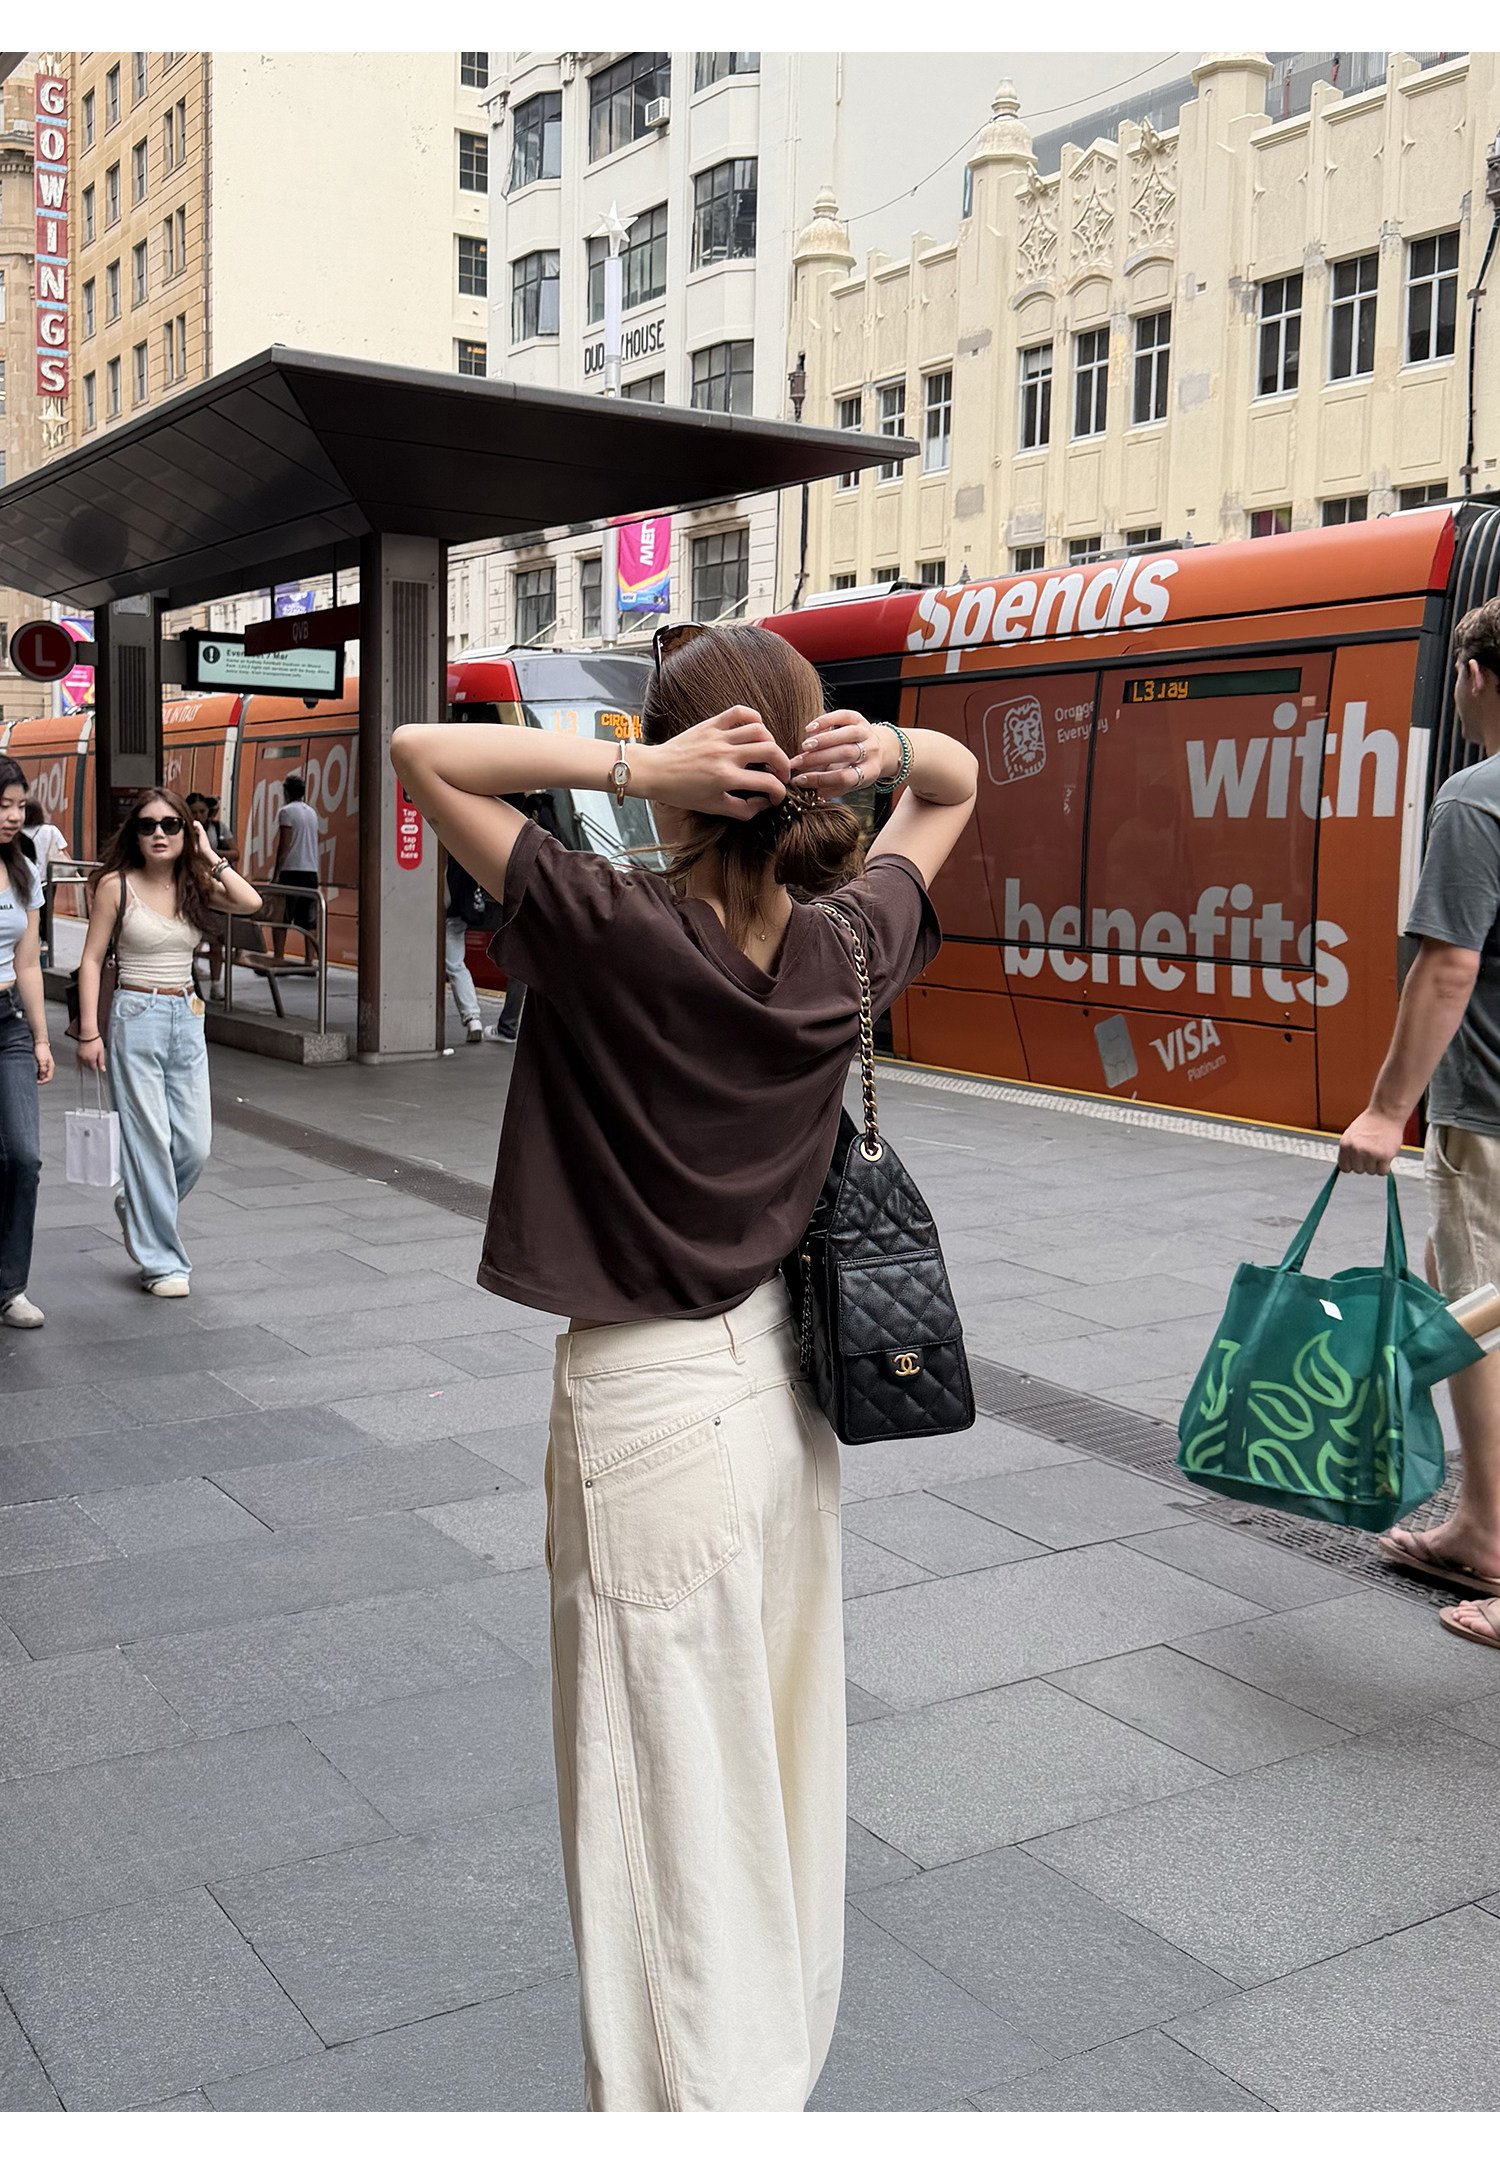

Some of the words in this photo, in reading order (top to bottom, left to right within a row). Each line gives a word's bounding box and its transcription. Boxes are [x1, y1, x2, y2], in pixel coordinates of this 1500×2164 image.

[39, 80, 66, 392] GOWINGS
[292, 620, 309, 643] QVB
[906, 555, 1179, 674] Spends
[34, 633, 56, 667] L
[1054, 700, 1094, 722] Orange
[1133, 680, 1154, 702] L3
[1186, 701, 1399, 820] with
[243, 735, 360, 878] APROL
[1003, 878, 1349, 1007] benefits
[1148, 1018, 1221, 1072] VISA
[1187, 1055, 1227, 1081] Platinum
